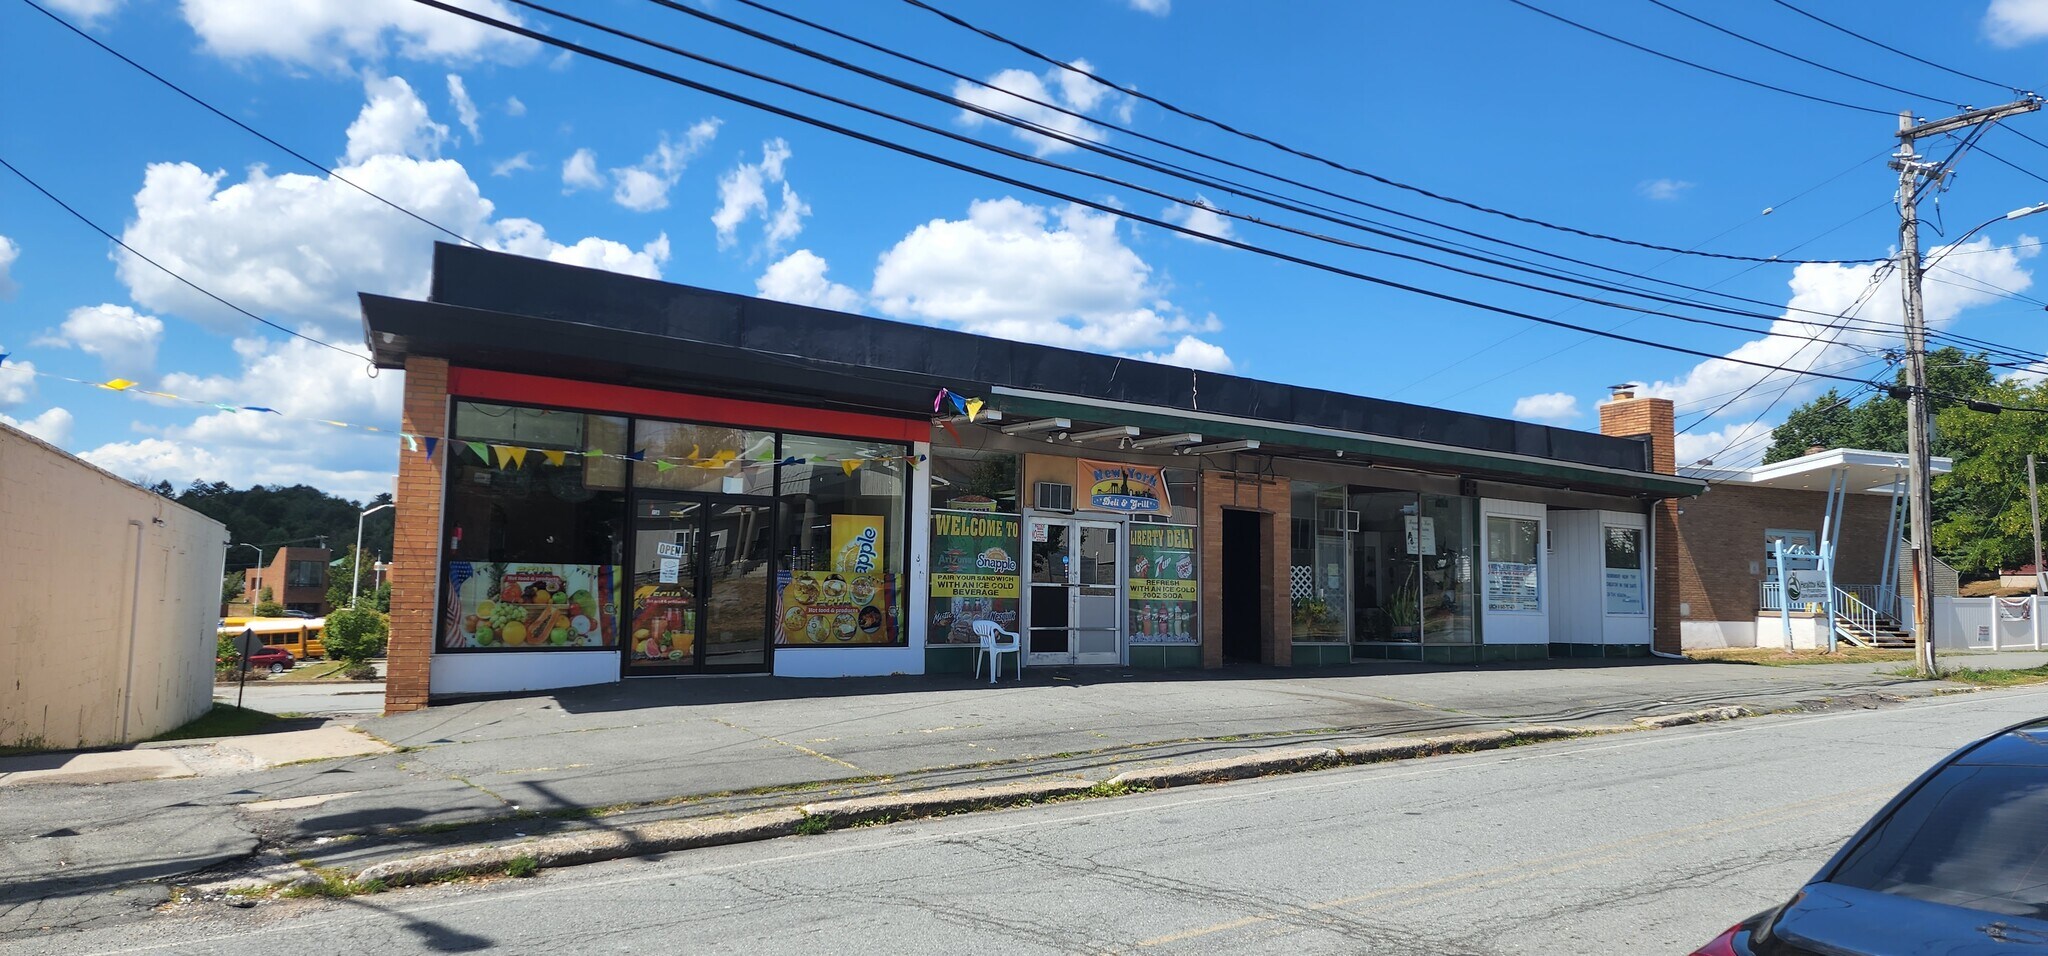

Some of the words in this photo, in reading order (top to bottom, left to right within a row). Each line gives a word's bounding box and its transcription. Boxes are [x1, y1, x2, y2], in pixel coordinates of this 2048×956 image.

[1093, 468, 1121, 481] New
[1127, 467, 1158, 487] York
[1102, 496, 1119, 506] Deli
[1121, 499, 1128, 507] &
[1130, 499, 1149, 510] Grill
[935, 514, 1003, 537] WELCOME
[1006, 521, 1018, 538] TO
[1130, 529, 1164, 547] LIBERTY
[1166, 528, 1194, 549] DELI
[659, 544, 681, 556] OPEN
[976, 552, 1016, 573] Snapple
